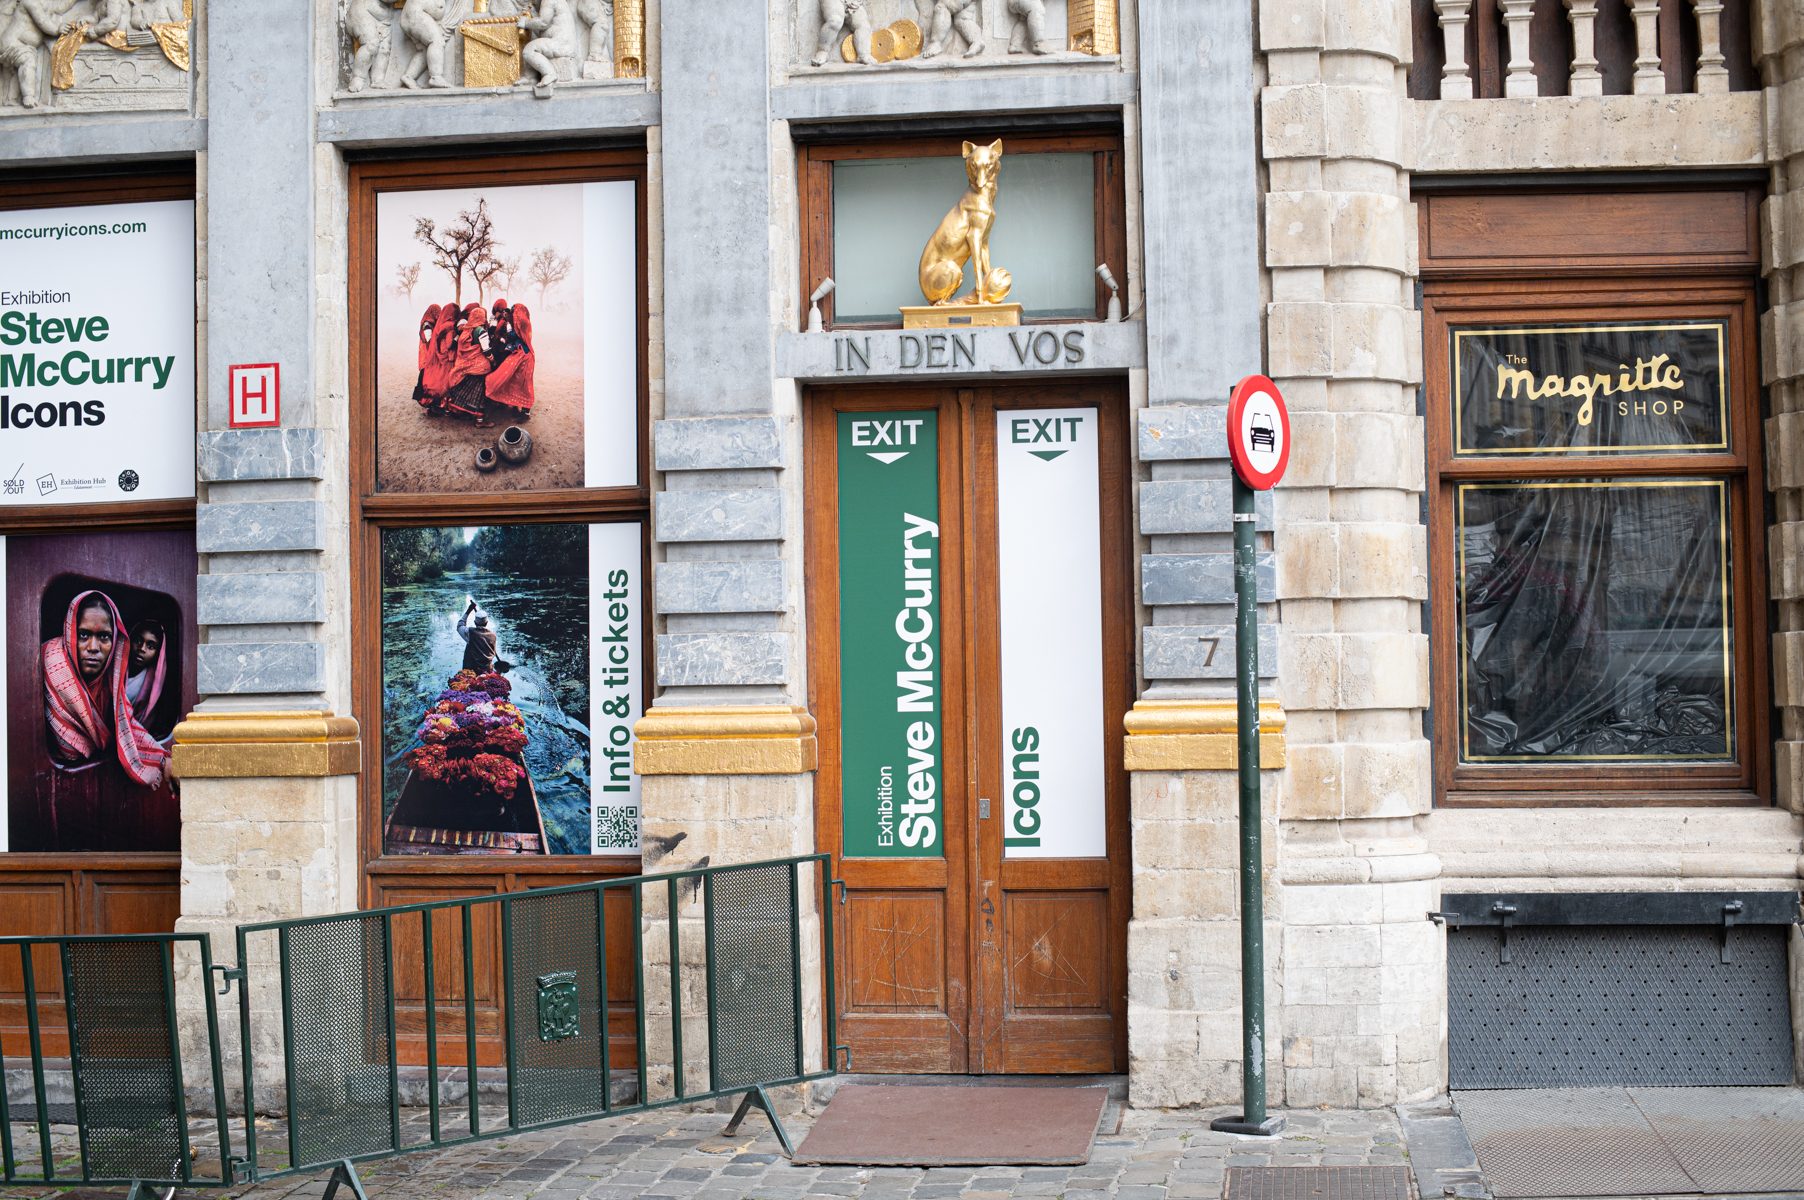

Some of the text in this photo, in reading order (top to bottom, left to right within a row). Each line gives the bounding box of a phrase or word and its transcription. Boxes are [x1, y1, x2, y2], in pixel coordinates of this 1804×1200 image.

[0, 223, 147, 240] mccurryicons.com
[1, 290, 71, 305] Exhibition
[0, 311, 109, 345] Steve
[834, 330, 1085, 371] IN DEN VOS
[1506, 354, 1527, 364] The
[0, 350, 175, 389] McCurry
[0, 395, 106, 429] Icons
[241, 375, 267, 415] H
[1618, 400, 1685, 416] SHOP
[851, 419, 923, 447] EXIT
[1011, 417, 1083, 444] EXIT
[41, 480, 53, 489] EH
[1198, 637, 1220, 667] 7
[602, 568, 631, 792] Info & tickets
[895, 512, 939, 848] Steve McCurry
[1004, 726, 1041, 848] Icons
[877, 766, 894, 847] Exhibition
